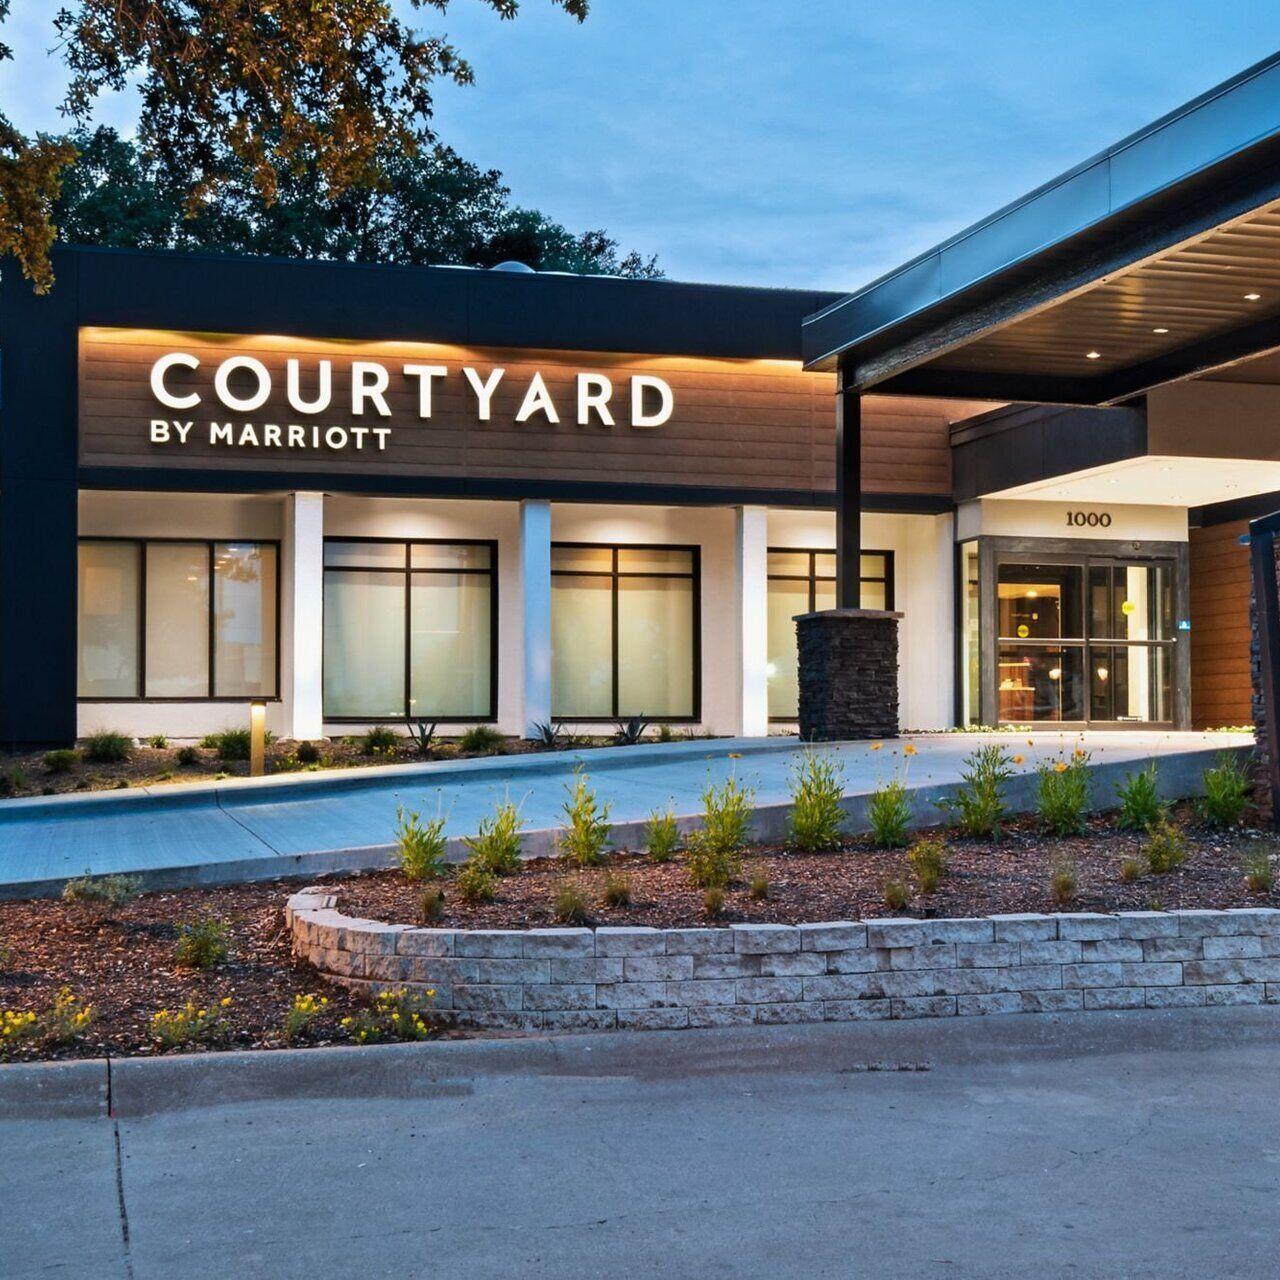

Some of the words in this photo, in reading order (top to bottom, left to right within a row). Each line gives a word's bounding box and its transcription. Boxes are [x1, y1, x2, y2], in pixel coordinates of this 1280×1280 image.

[150, 352, 674, 427] COURTYARD
[150, 420, 194, 443] BY
[210, 422, 392, 450] MARRIOTT
[1066, 511, 1112, 528] 1000
